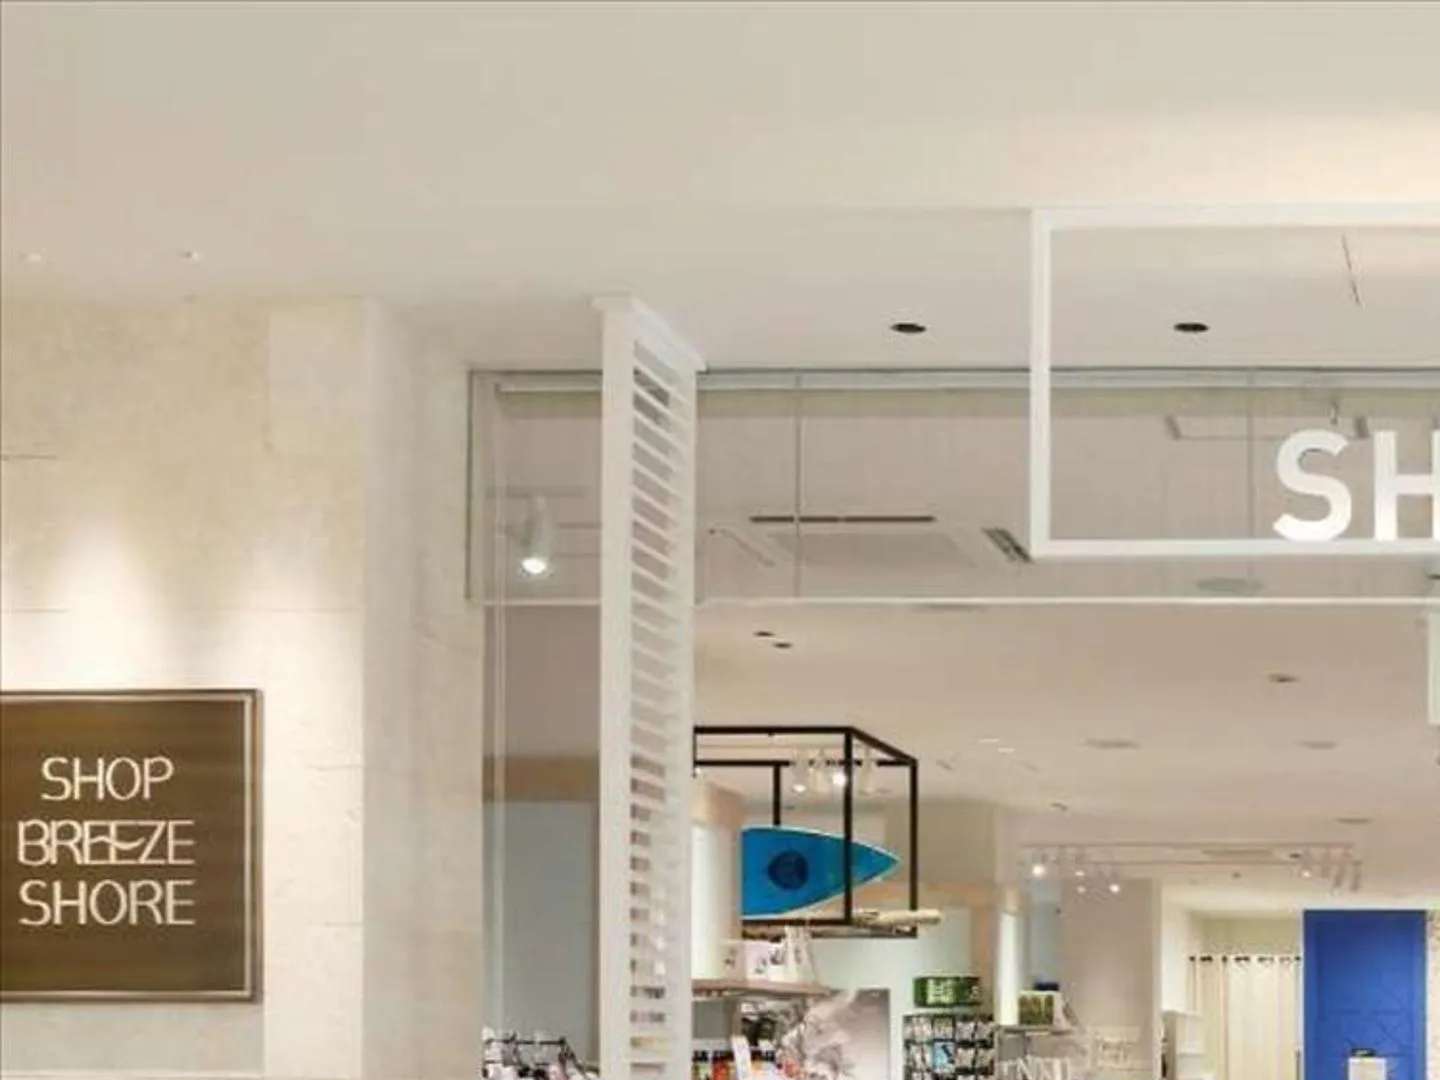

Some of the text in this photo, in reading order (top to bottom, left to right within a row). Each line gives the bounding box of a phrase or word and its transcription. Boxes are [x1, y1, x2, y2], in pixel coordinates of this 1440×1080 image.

[41, 756, 175, 801] SHOP
[17, 818, 195, 866] BREEZE
[18, 879, 195, 926] SHORE
